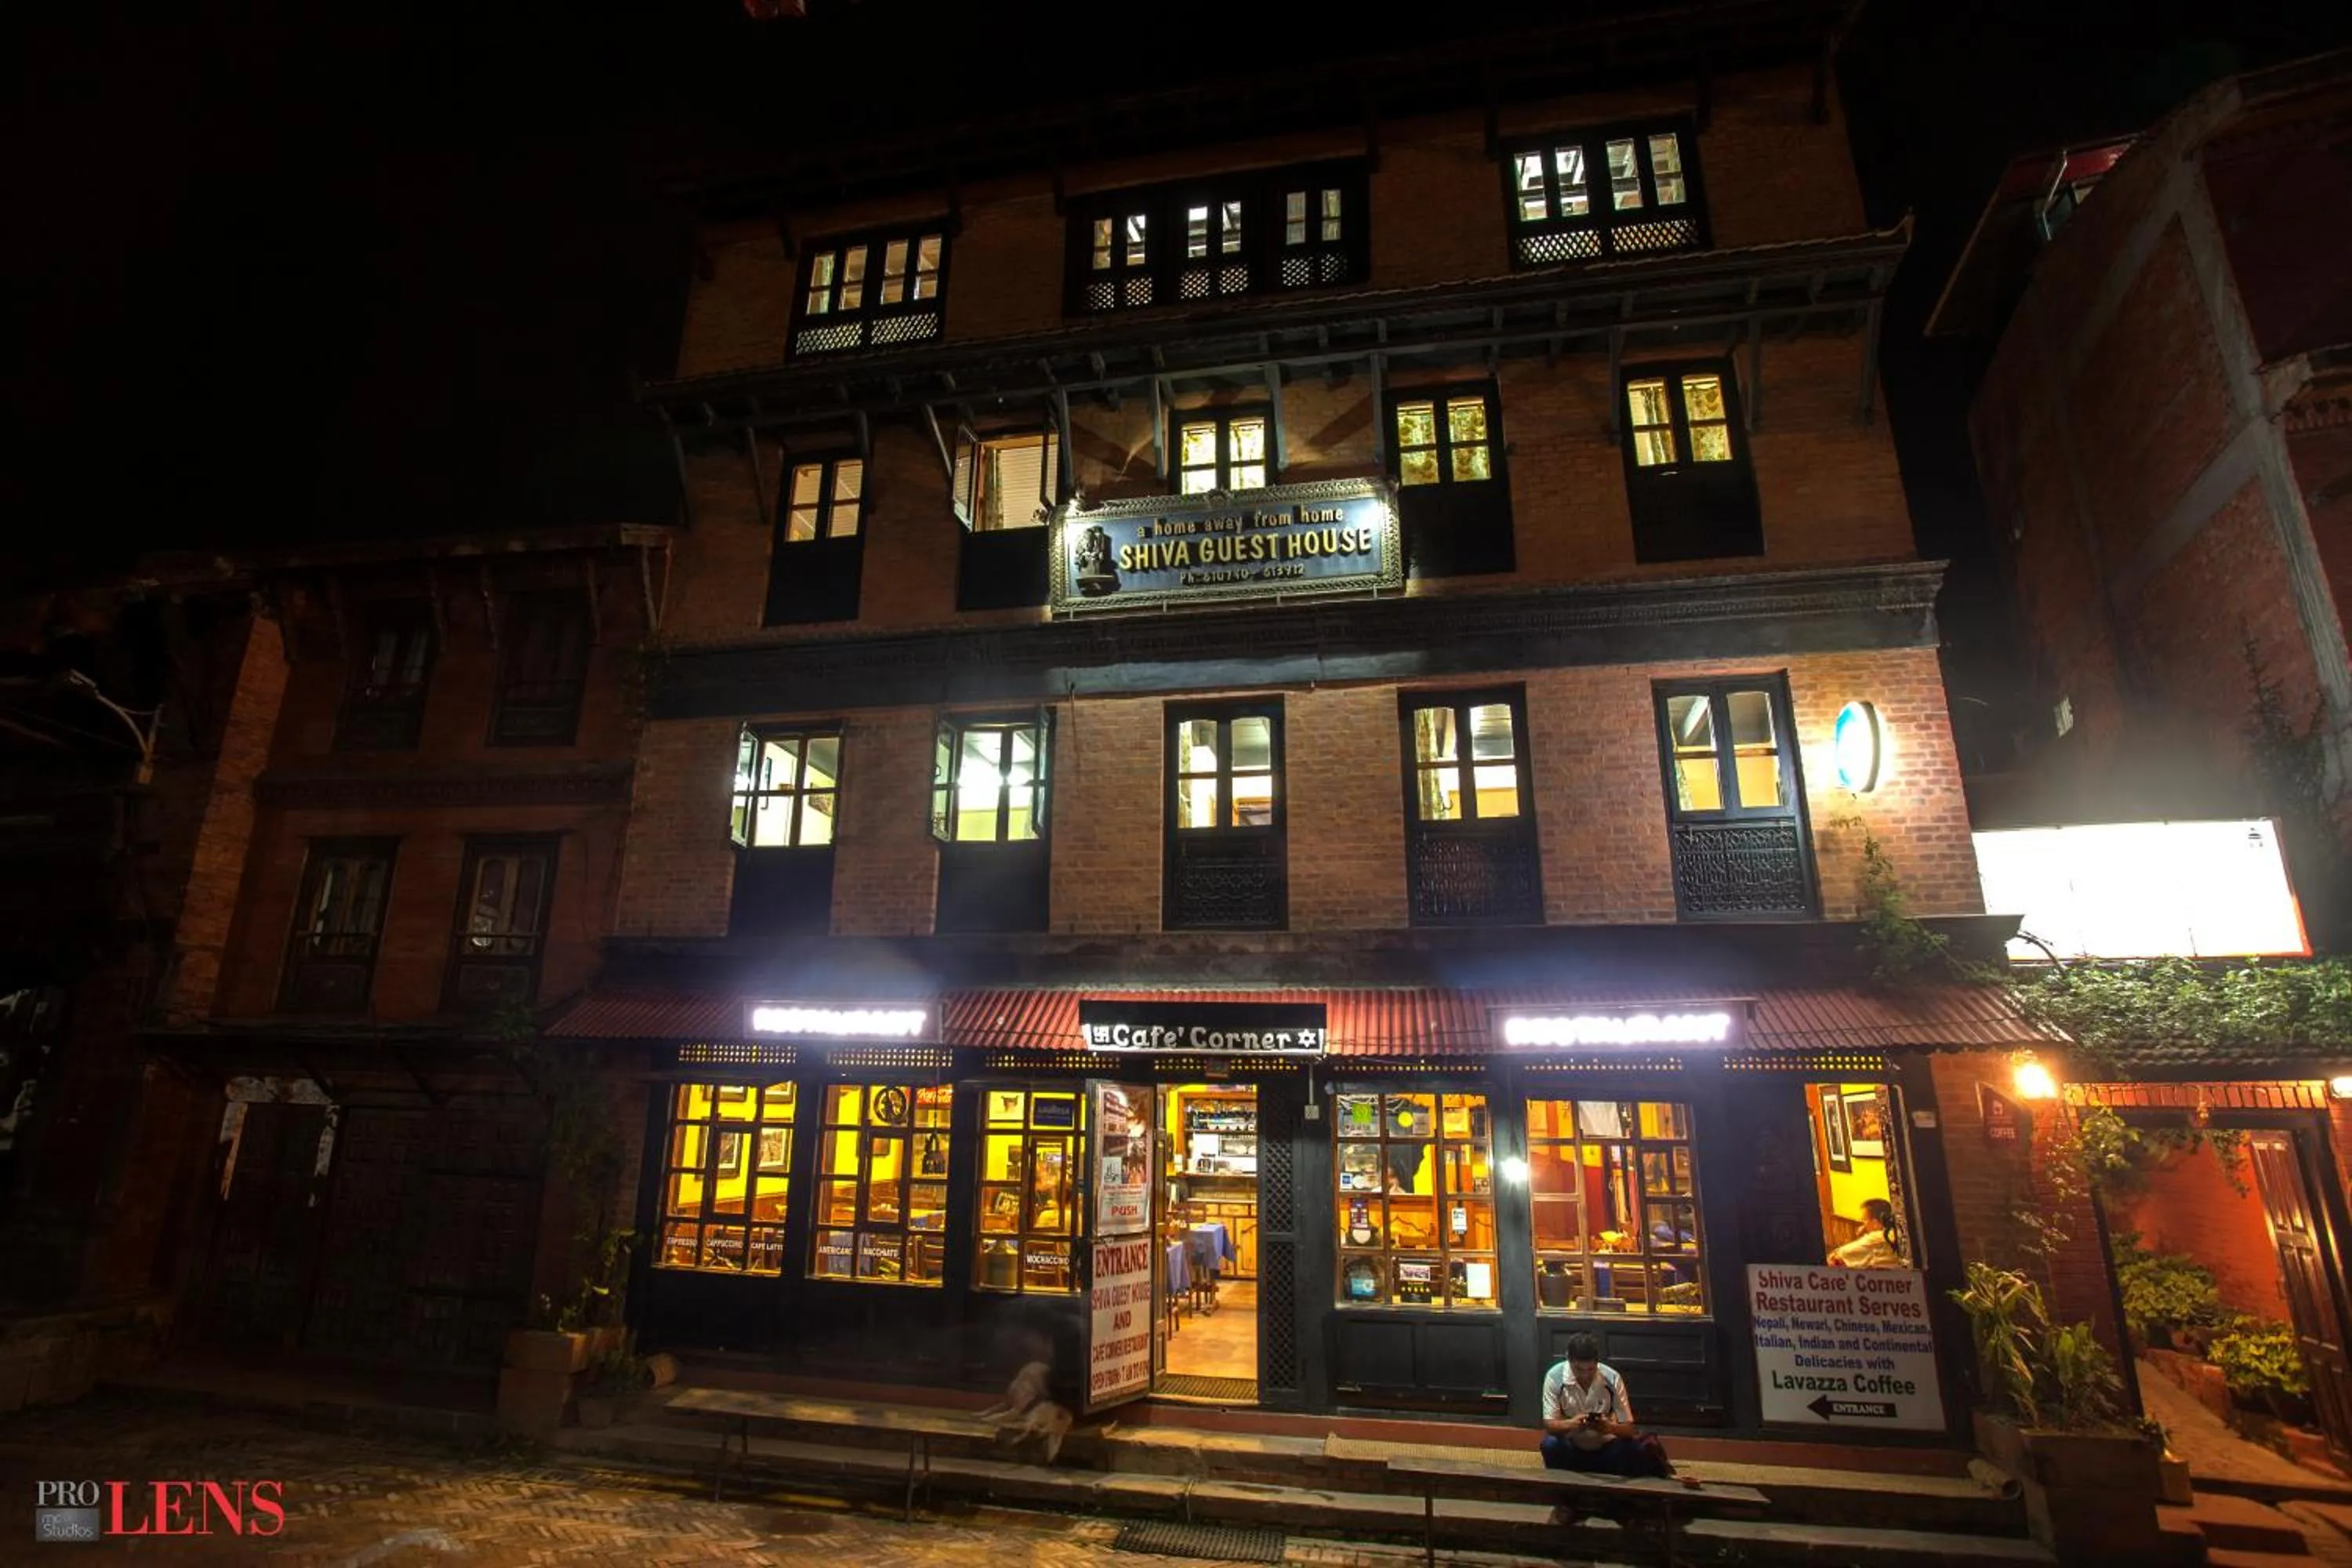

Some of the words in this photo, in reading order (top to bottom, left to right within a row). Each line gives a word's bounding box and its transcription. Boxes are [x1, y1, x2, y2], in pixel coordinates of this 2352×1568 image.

[1137, 526, 1145, 538] a
[1153, 517, 1196, 536] home
[1204, 514, 1243, 535] away
[1254, 510, 1292, 528] from
[1300, 504, 1344, 523] home
[1118, 539, 1190, 571] SHIVA
[1199, 532, 1279, 564] GUEST
[1288, 526, 1372, 559] HOUSE
[1190, 1026, 1292, 1050] Corner
[1095, 1242, 1149, 1278] ENTRANCE
[1758, 1270, 1802, 1290] Shiva
[1855, 1272, 1912, 1294] Corner
[1755, 1291, 1853, 1315] Restaurant
[1859, 1294, 1922, 1318] Serves
[1113, 1310, 1131, 1330] AND
[1755, 1334, 1796, 1351] Italian,
[1798, 1334, 1835, 1349] Indian
[1838, 1337, 1860, 1350] and
[1863, 1337, 1933, 1353] Continental
[1795, 1354, 1863, 1370] Delicacies
[1867, 1356, 1895, 1370] with
[1772, 1370, 1848, 1392] Lavazza
[1853, 1373, 1916, 1396] Coffee
[1832, 1403, 1885, 1415] ENTRANCE
